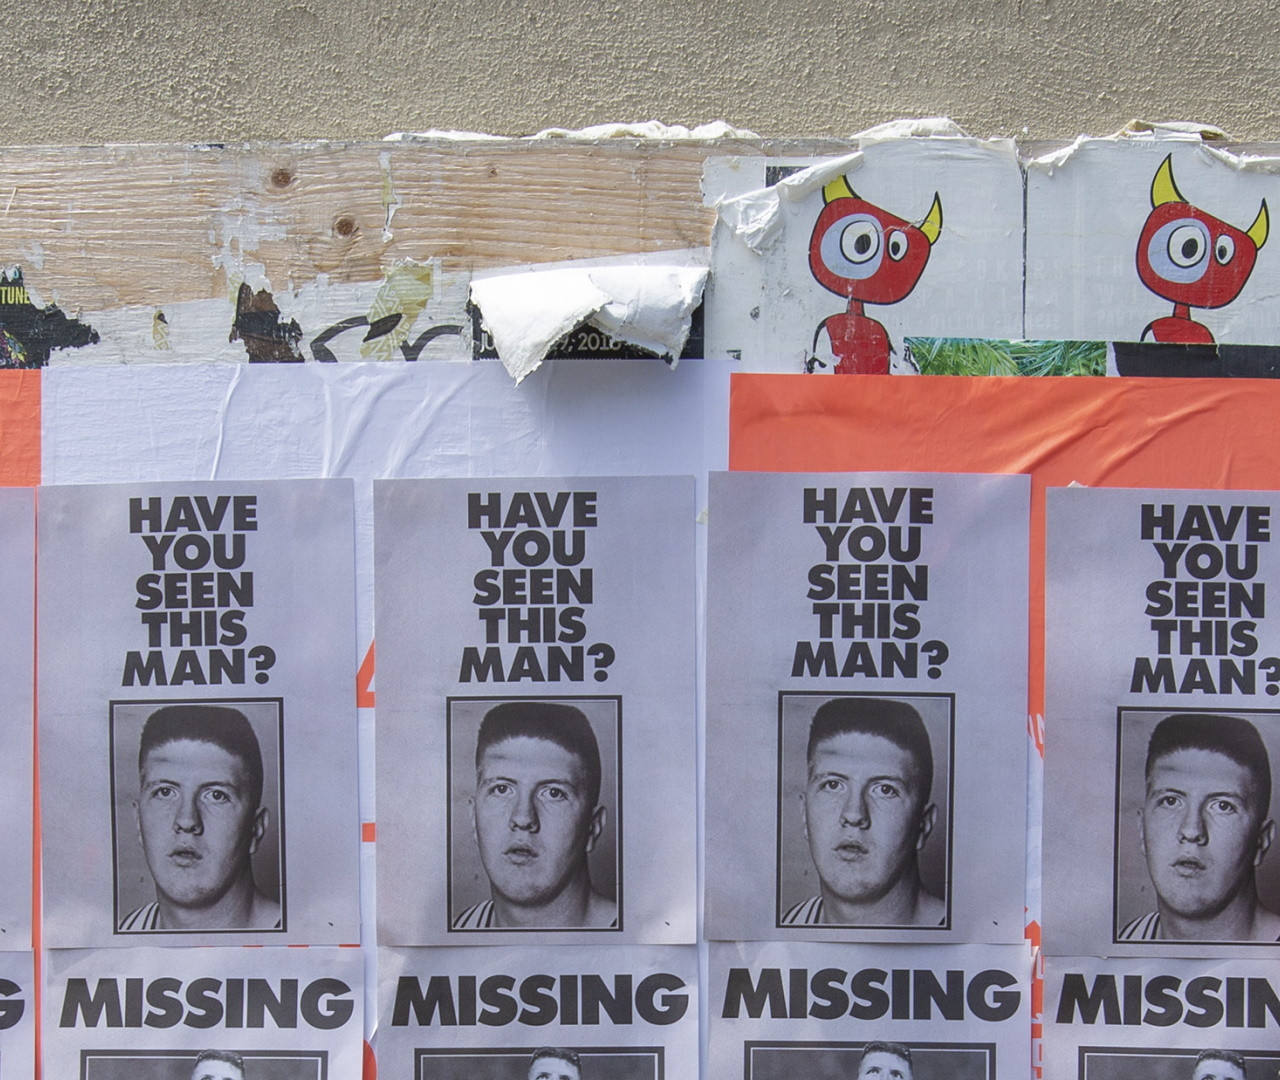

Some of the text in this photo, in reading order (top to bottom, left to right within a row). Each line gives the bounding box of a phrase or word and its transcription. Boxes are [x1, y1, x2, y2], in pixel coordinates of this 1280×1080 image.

[129, 495, 258, 534] HAVE
[467, 491, 598, 529] HAVE
[802, 487, 934, 525] HAVE
[1140, 503, 1271, 543] HAVE
[141, 533, 246, 572] YOU
[479, 529, 586, 568] YOU
[814, 525, 922, 563] YOU
[1152, 542, 1259, 581] YOU
[135, 571, 254, 611] SEEN
[472, 568, 594, 607] SEEN
[806, 563, 929, 602] SEEN
[1144, 580, 1266, 619] SEEN
[141, 609, 248, 648] THIS
[478, 606, 587, 644] THIS
[812, 602, 921, 641] THIS
[1150, 618, 1259, 657] THIS
[121, 645, 277, 687] MAN?
[458, 642, 616, 684] MAN?
[790, 639, 950, 680] MAN?
[59, 977, 354, 1030] MISSING
[391, 972, 689, 1027] MISSING
[721, 968, 1021, 1022] MISSING
